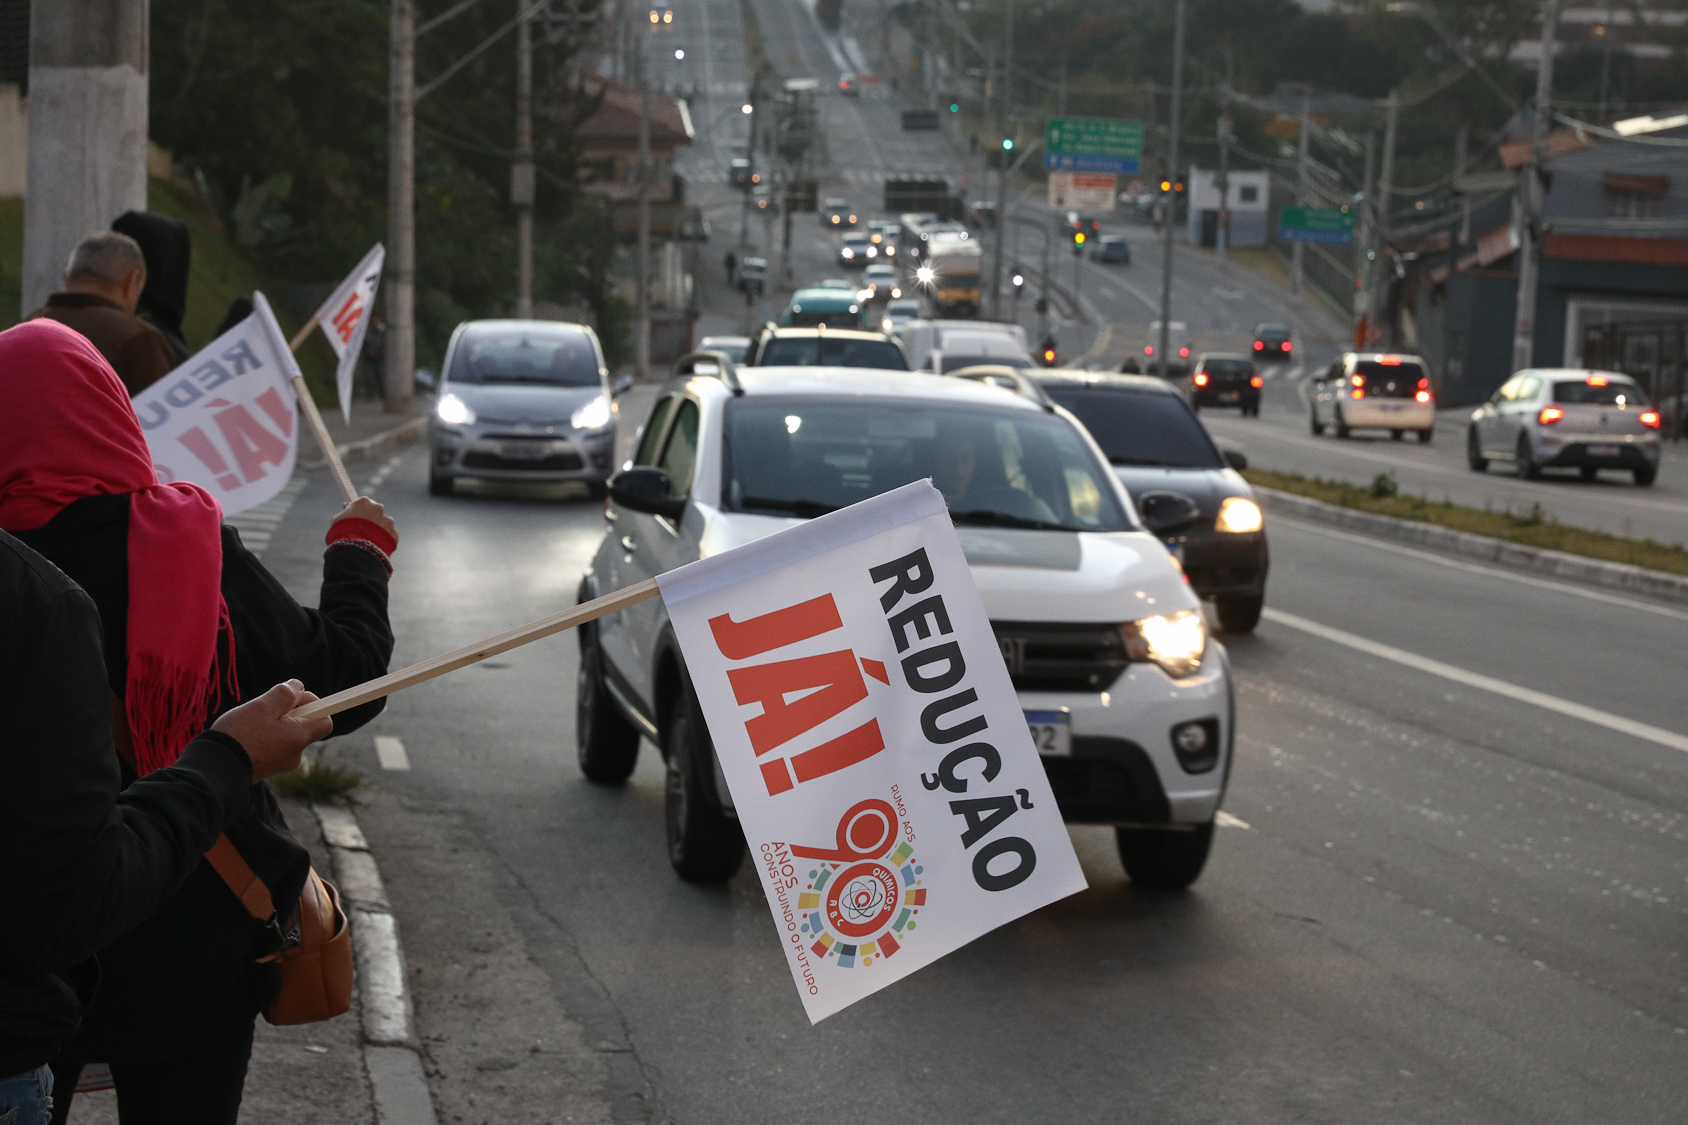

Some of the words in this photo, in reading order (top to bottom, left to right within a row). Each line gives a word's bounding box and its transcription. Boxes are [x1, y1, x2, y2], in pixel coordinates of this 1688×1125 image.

[707, 592, 890, 797] JÁ!
[868, 546, 1037, 892] REDUÇÃO
[890, 783, 907, 817] RUMO
[902, 820, 916, 843] AOS
[760, 843, 796, 931] CONSTRUINDO
[771, 841, 798, 889] ANOS
[872, 867, 895, 911] QUÍMICOS
[791, 933, 800, 944] O
[794, 944, 819, 996] FUTURO
